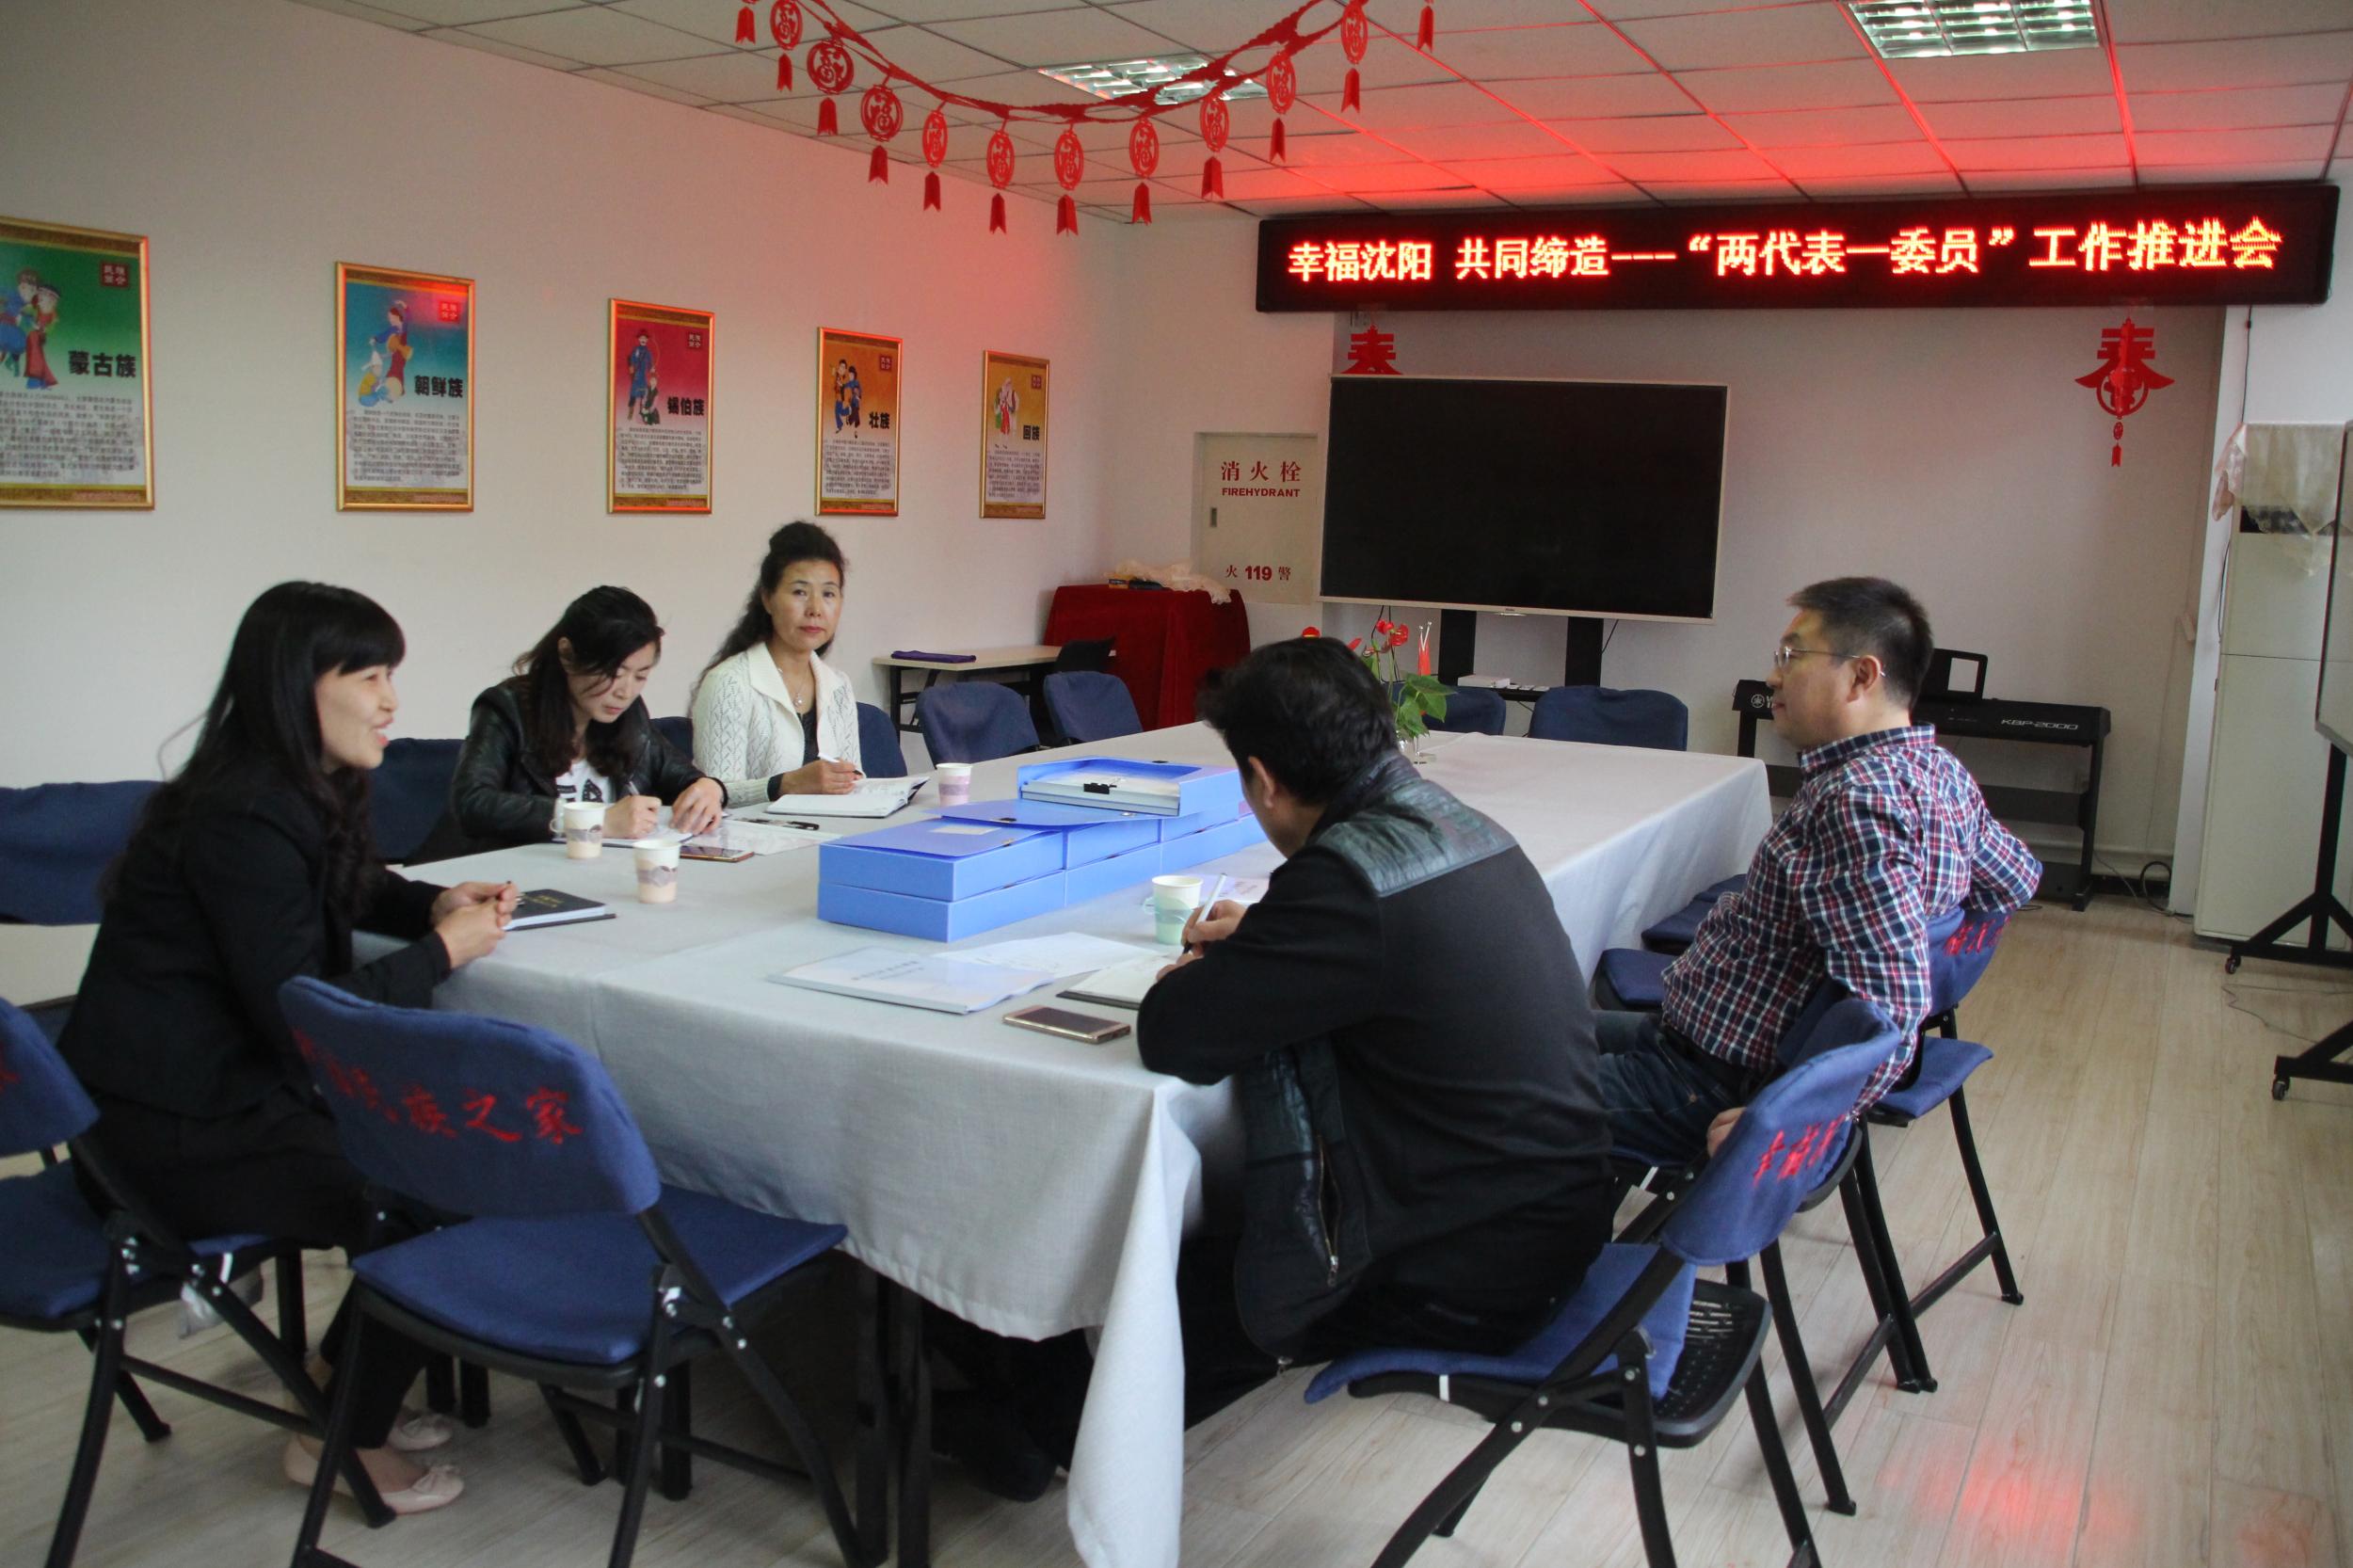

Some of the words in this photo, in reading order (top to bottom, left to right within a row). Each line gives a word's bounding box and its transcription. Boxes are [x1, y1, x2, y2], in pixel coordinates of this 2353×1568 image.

[1288, 240, 1433, 281] 幸福沈阳
[69, 350, 136, 377] 蒙古族
[414, 375, 463, 398] 朝鲜族
[1221, 460, 1302, 482] 消火栓
[1222, 488, 1301, 498] FIREHYDRANT
[1225, 565, 1239, 579] 火
[1244, 566, 1273, 581] 119
[2001, 719, 2078, 730] KBP-2000
